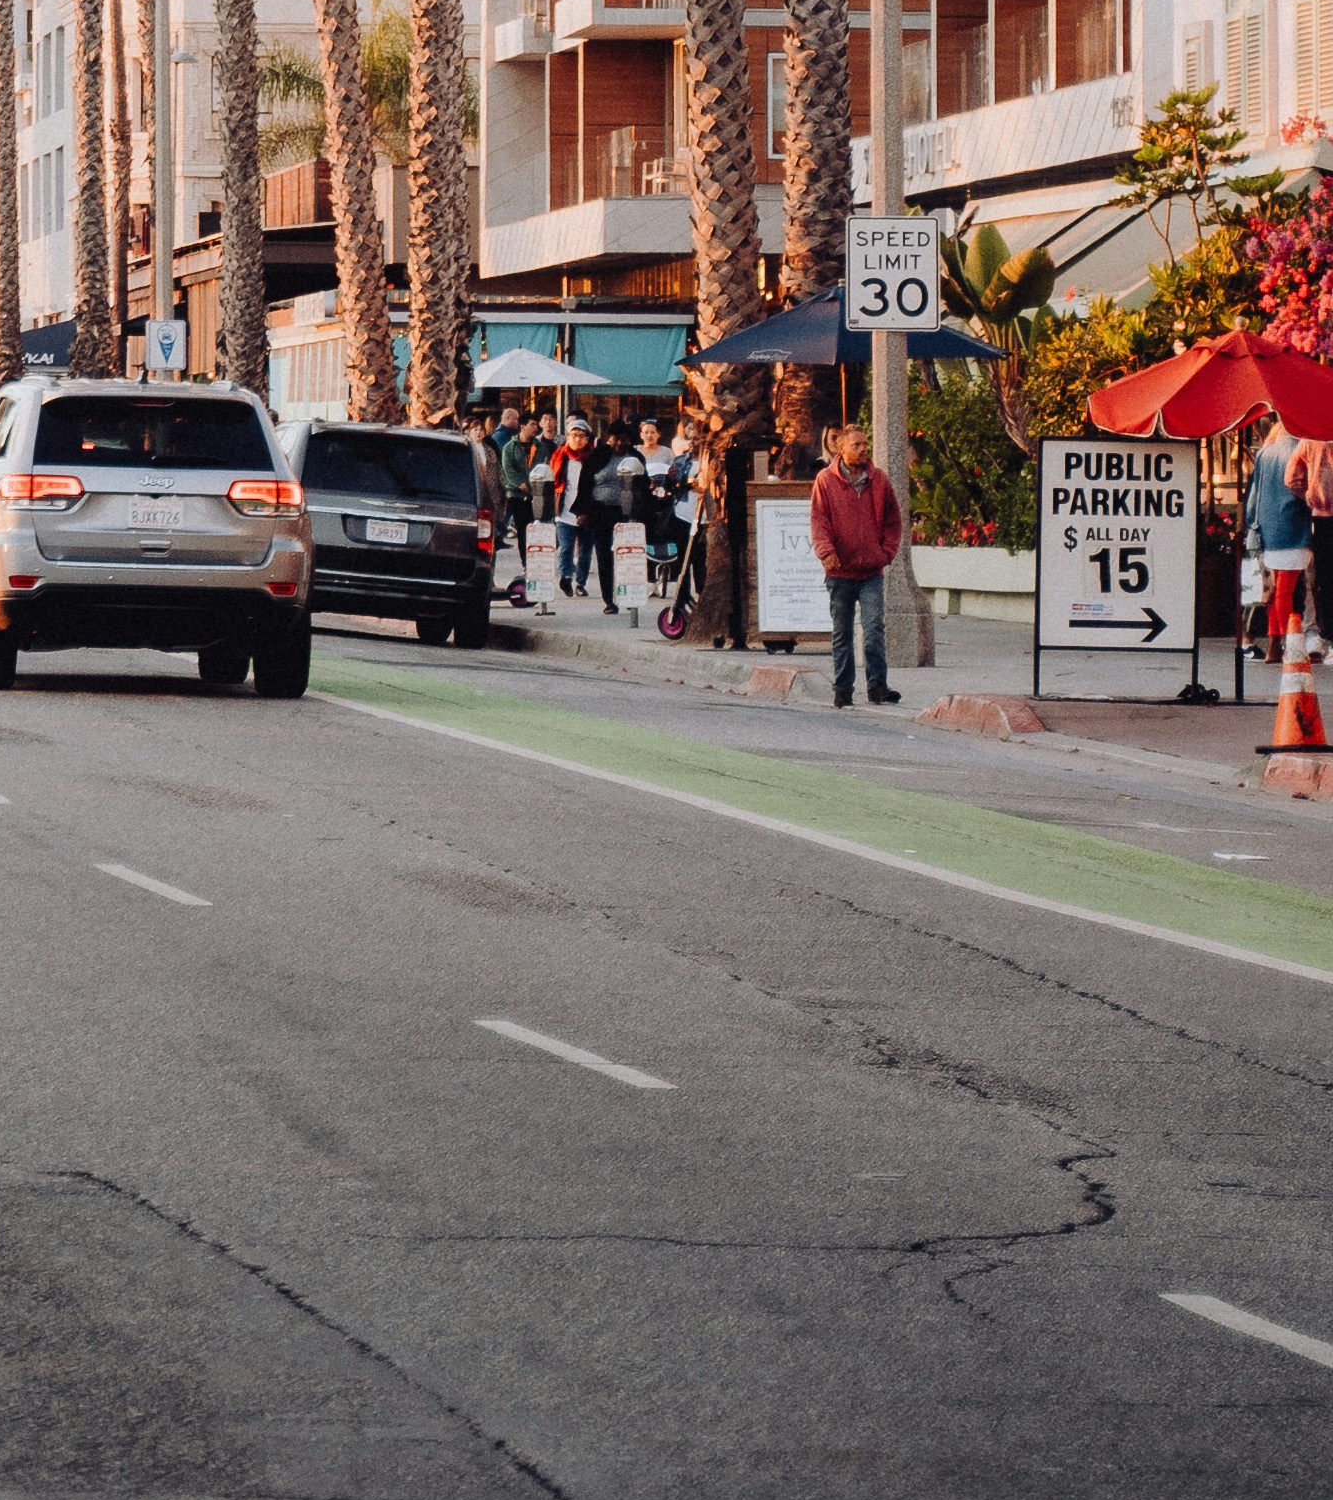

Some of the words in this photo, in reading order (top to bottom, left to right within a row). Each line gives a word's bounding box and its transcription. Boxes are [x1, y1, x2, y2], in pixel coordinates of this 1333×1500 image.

[856, 231, 930, 247] SPEED
[864, 254, 921, 270] LIMIT
[859, 277, 929, 317] 30
[1064, 452, 1174, 482] PUBLIC
[139, 474, 175, 489] Jeep
[1052, 487, 1184, 518] PARKING
[779, 530, 813, 554] Ivy
[1064, 525, 1078, 552] $
[1086, 527, 1114, 541] ALL
[1119, 527, 1151, 541] DAY
[1089, 547, 1150, 594] 15
